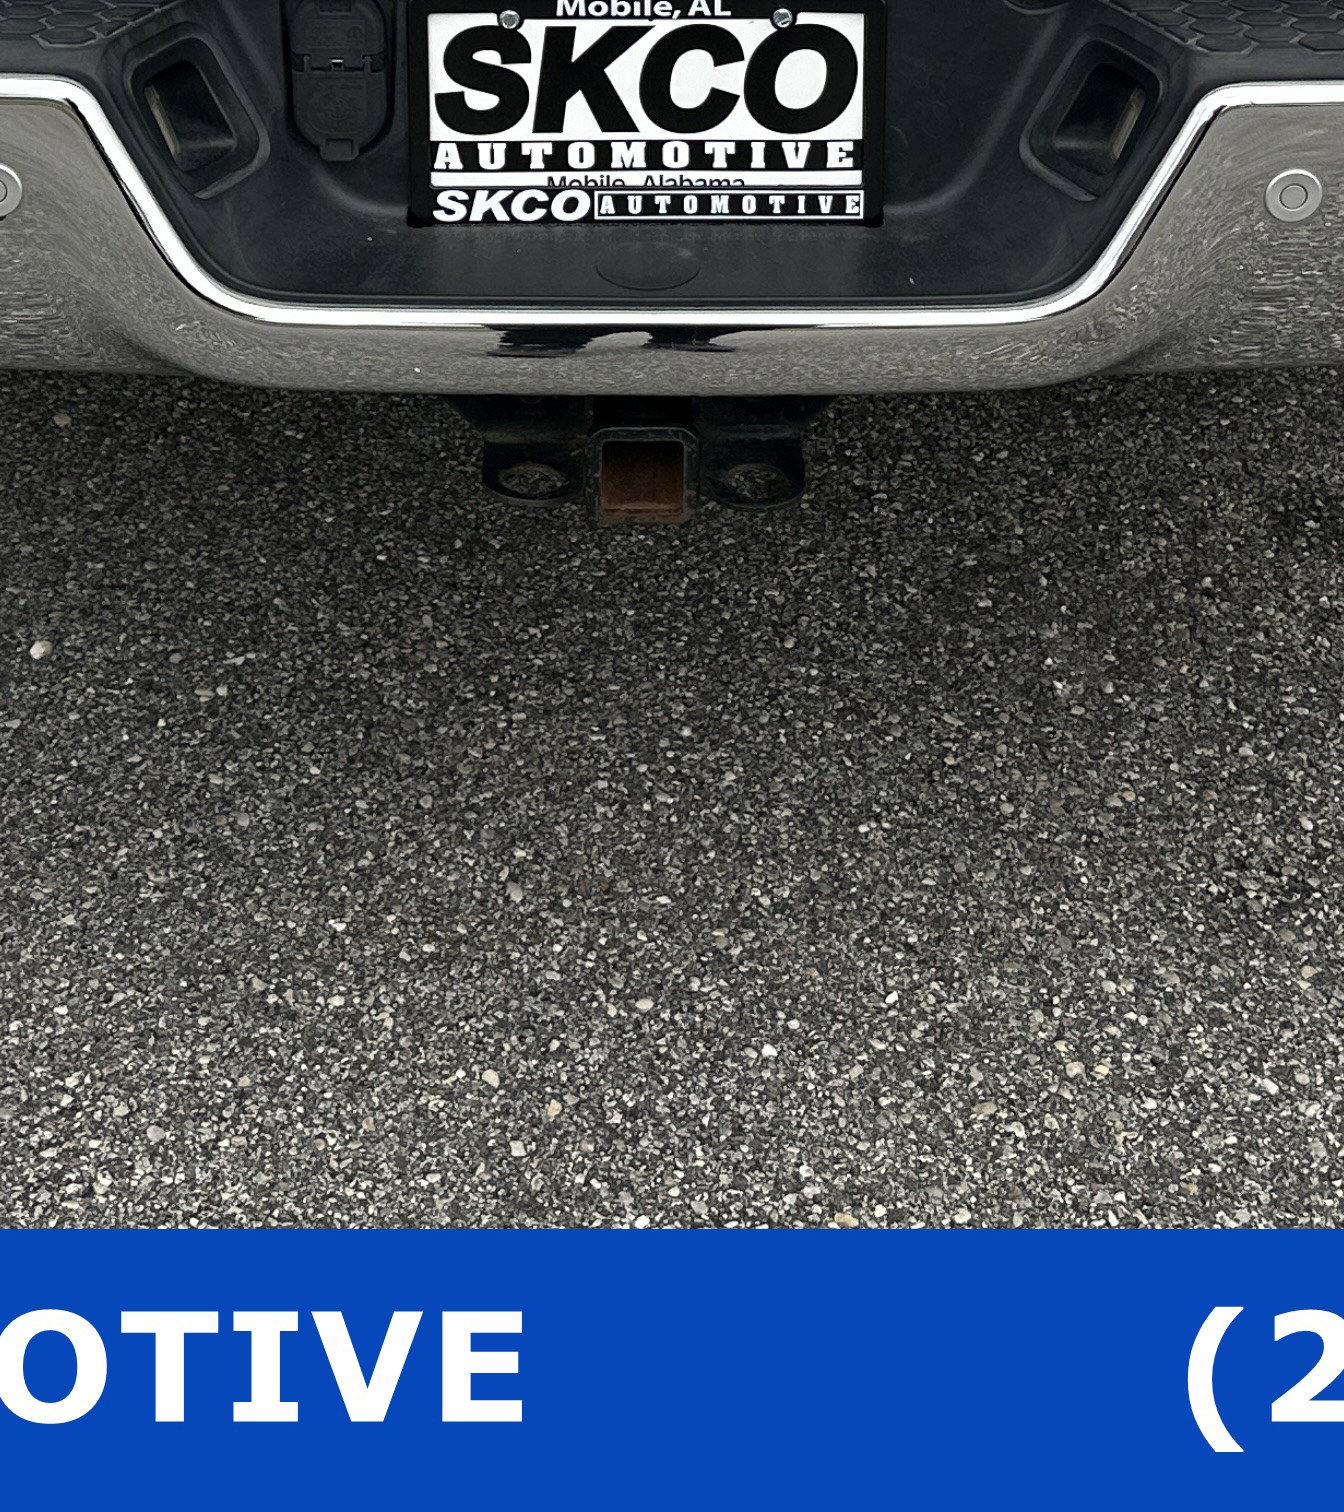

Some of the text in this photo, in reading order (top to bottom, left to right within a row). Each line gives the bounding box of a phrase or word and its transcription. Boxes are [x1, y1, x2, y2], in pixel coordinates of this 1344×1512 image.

[434, 23, 859, 135] SKCO
[433, 141, 854, 170] AUTOMOTIVE
[432, 189, 860, 222] SKCO AUTOMOTIVE
